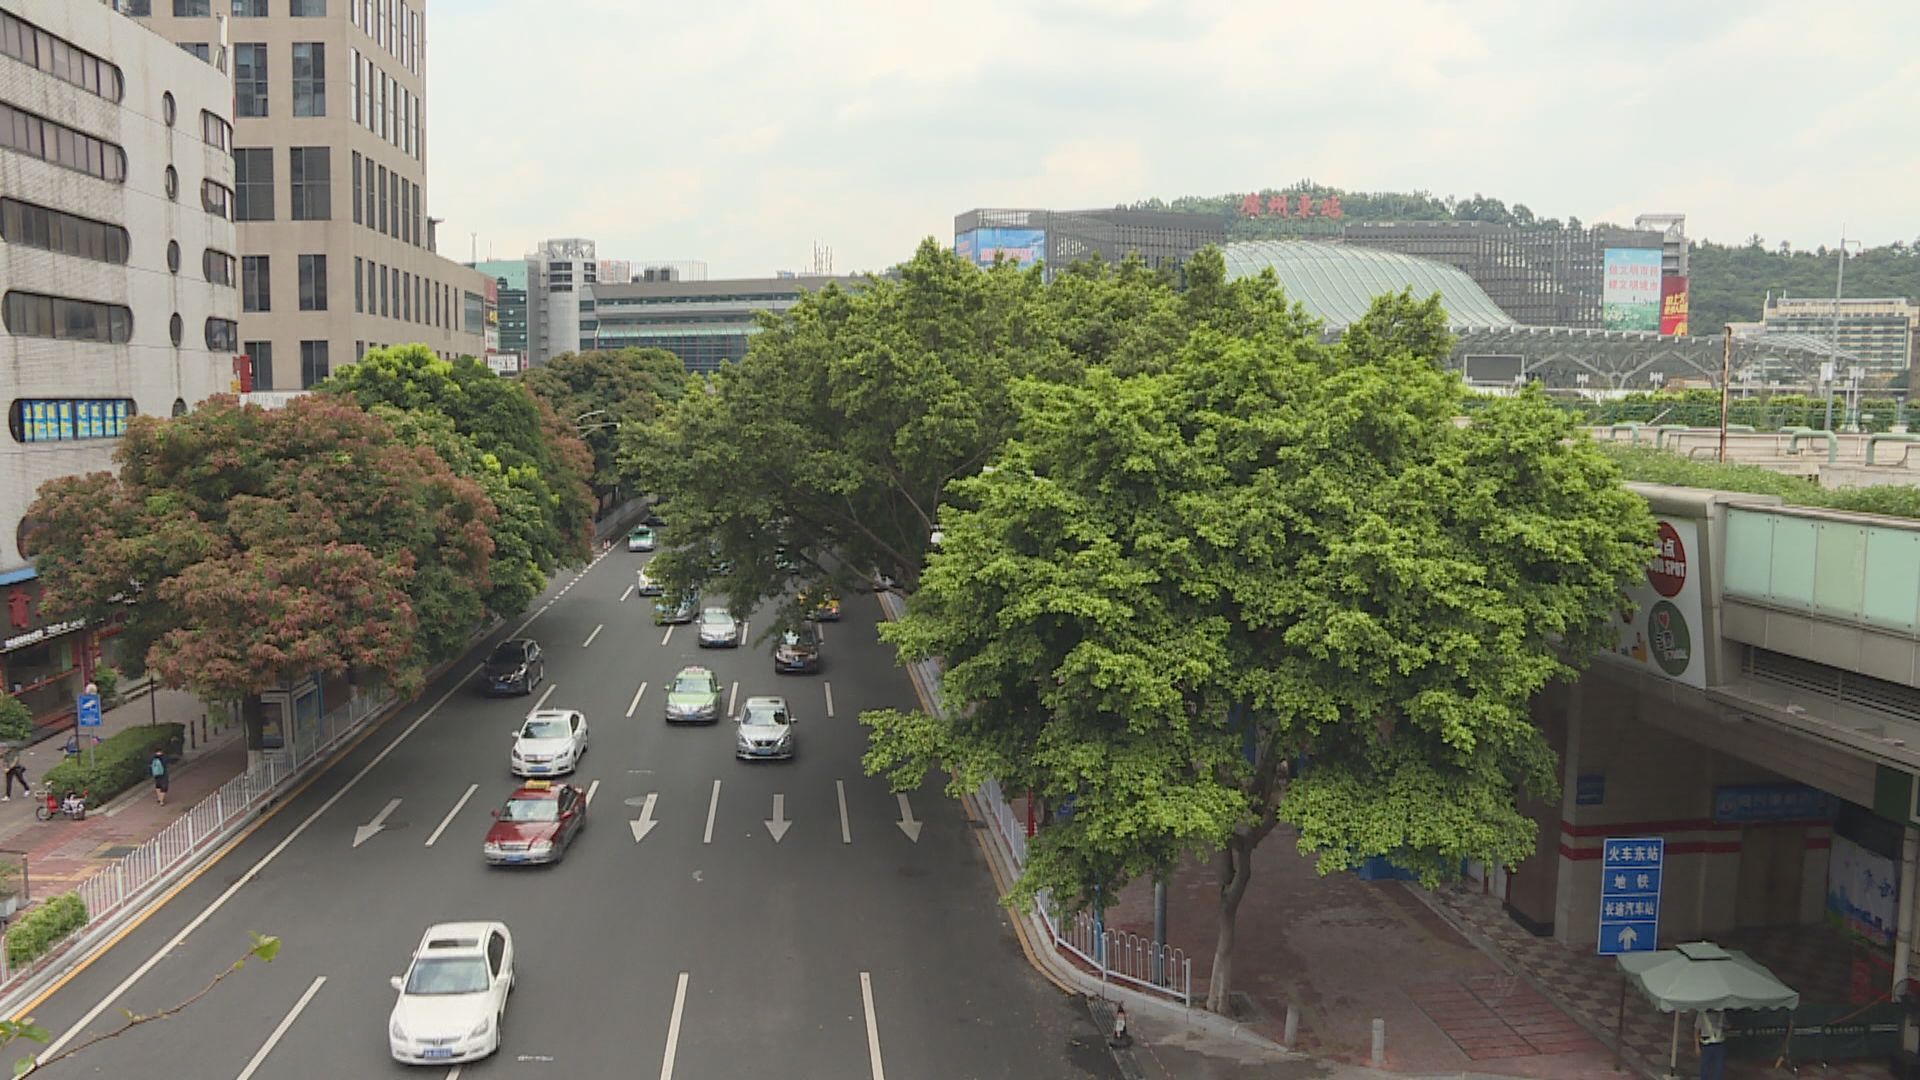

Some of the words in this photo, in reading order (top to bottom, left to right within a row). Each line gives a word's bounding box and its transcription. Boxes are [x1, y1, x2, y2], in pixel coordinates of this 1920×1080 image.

[1665, 560, 1685, 577] SPOT
[1608, 846, 1658, 861] 火车东站
[1614, 873, 1649, 889] 地铁
[1605, 901, 1654, 916] 长途汽车站
